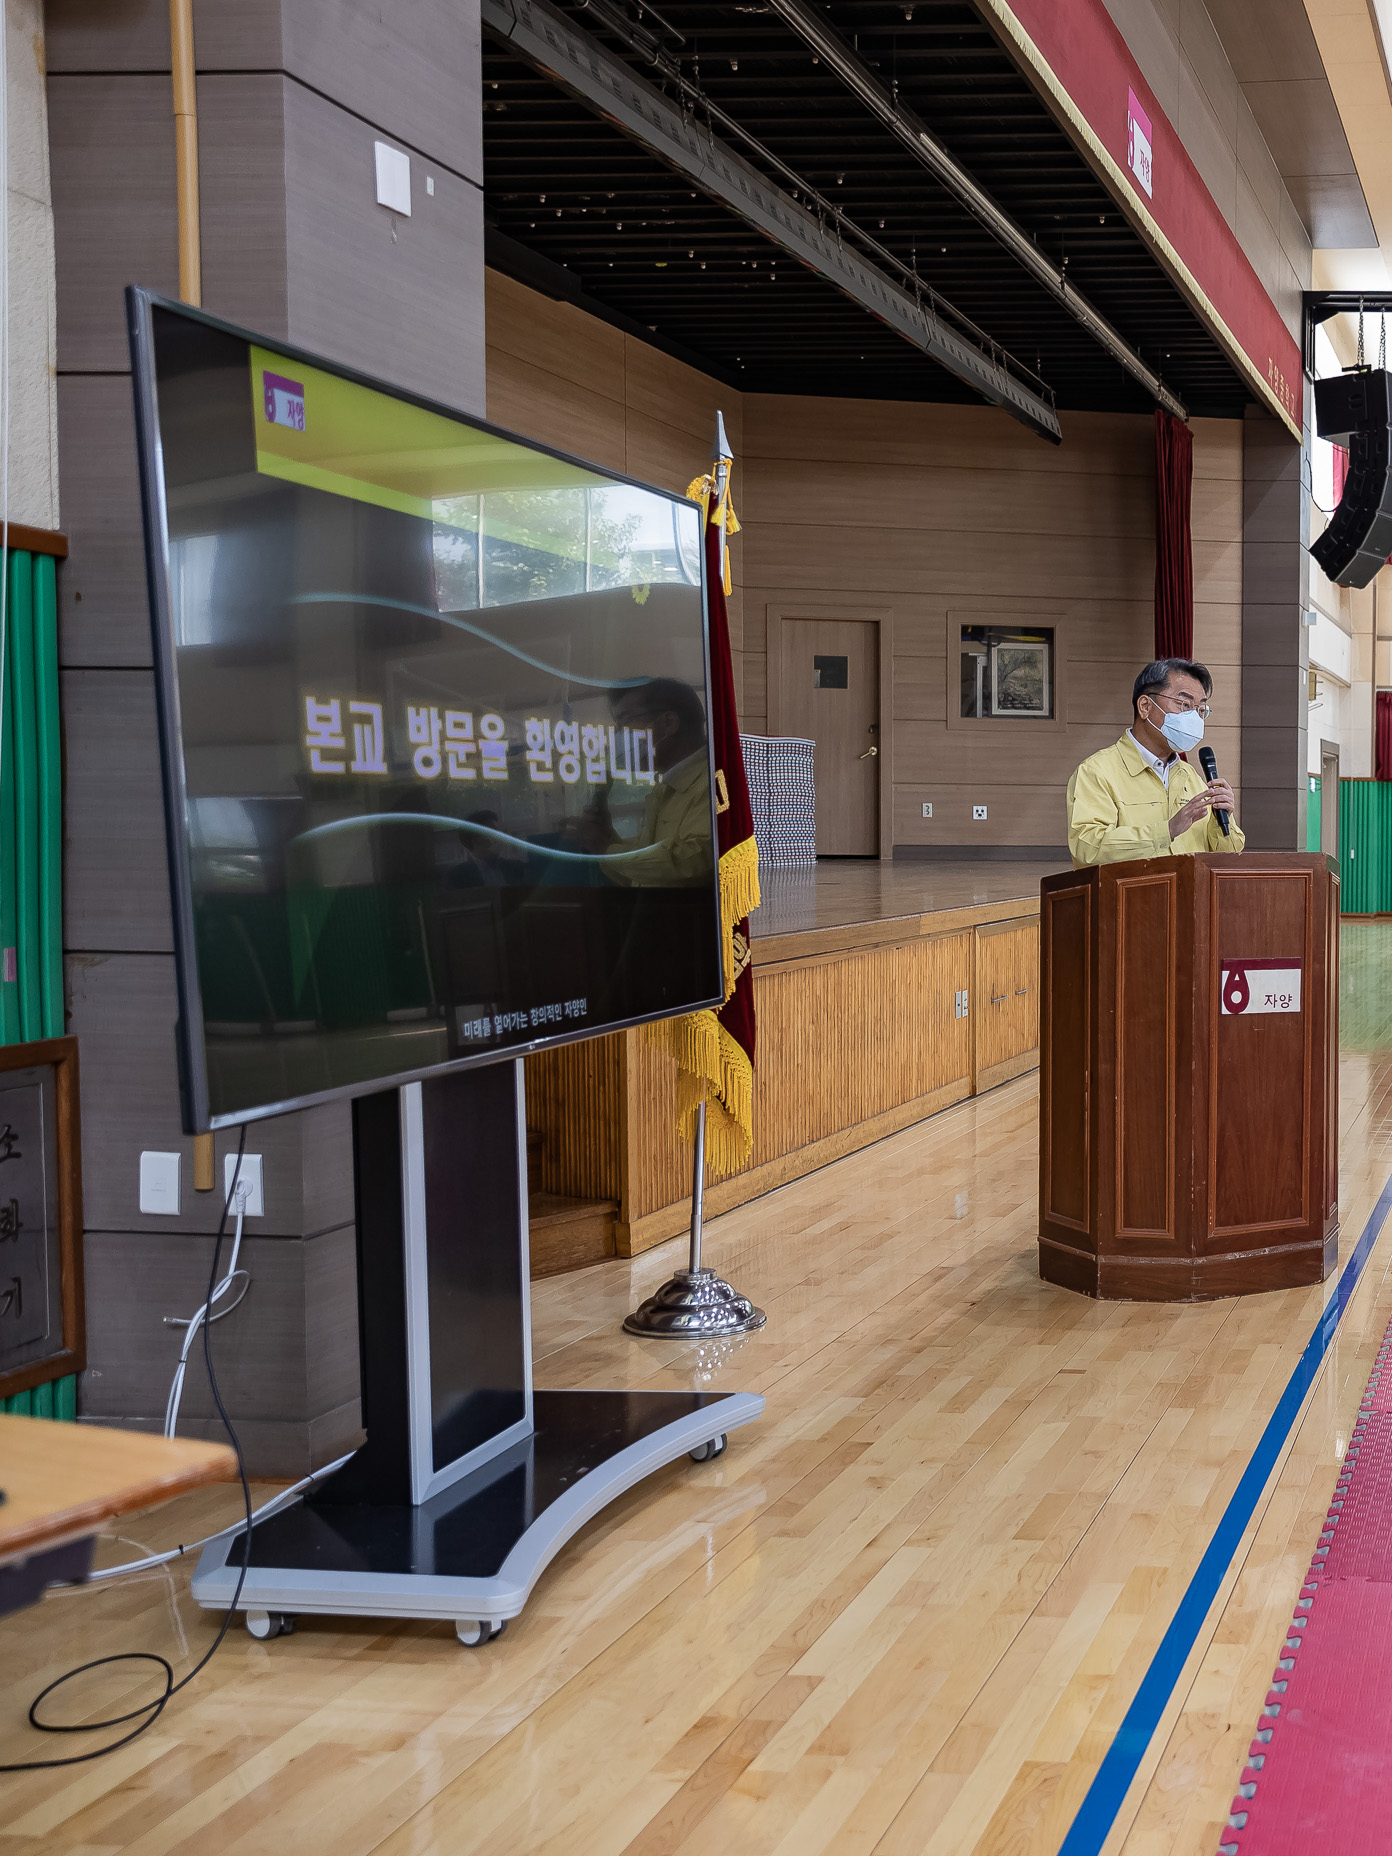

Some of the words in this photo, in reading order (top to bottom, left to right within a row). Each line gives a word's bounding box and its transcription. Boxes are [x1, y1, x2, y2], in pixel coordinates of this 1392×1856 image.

[1140, 149, 1150, 183] 자양
[287, 399, 305, 431] 자양
[305, 696, 389, 775] 본교
[407, 705, 509, 781] 방문을
[1264, 993, 1293, 1009] 자양
[463, 1017, 491, 1040] 미래를
[494, 1011, 528, 1034] 열어가는
[530, 1003, 563, 1026] 창의적인
[564, 998, 588, 1018] 자양인
